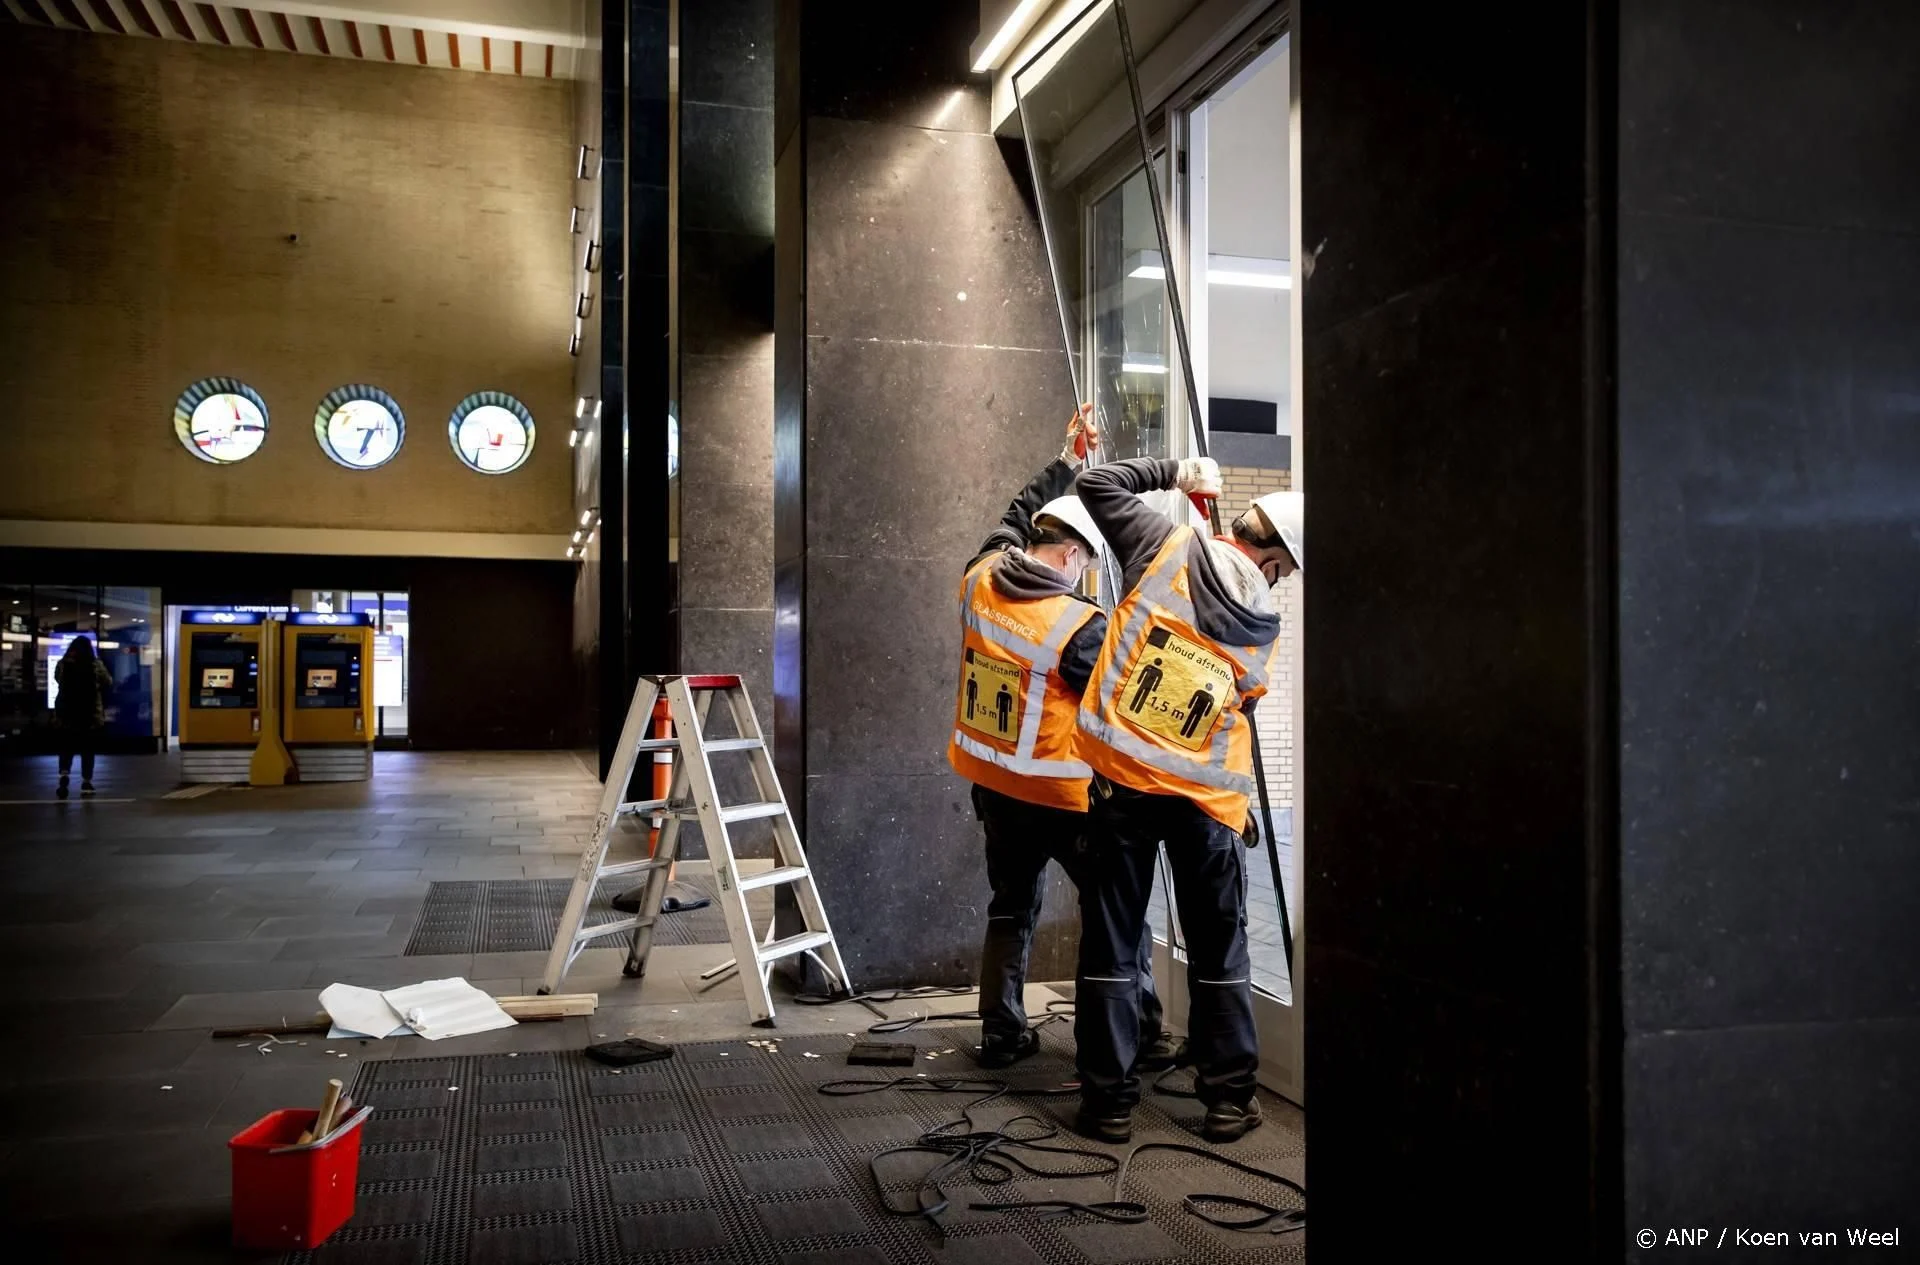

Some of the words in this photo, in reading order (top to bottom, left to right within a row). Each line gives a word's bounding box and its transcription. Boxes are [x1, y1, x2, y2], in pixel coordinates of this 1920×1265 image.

[973, 600, 1038, 640] GLASSERVICE
[1167, 641, 1196, 661] houd
[974, 656, 989, 669] houd
[990, 664, 1020, 678] afstand
[988, 710, 997, 720] m
[1150, 696, 1170, 713] 1,5
[1171, 707, 1186, 721] m
